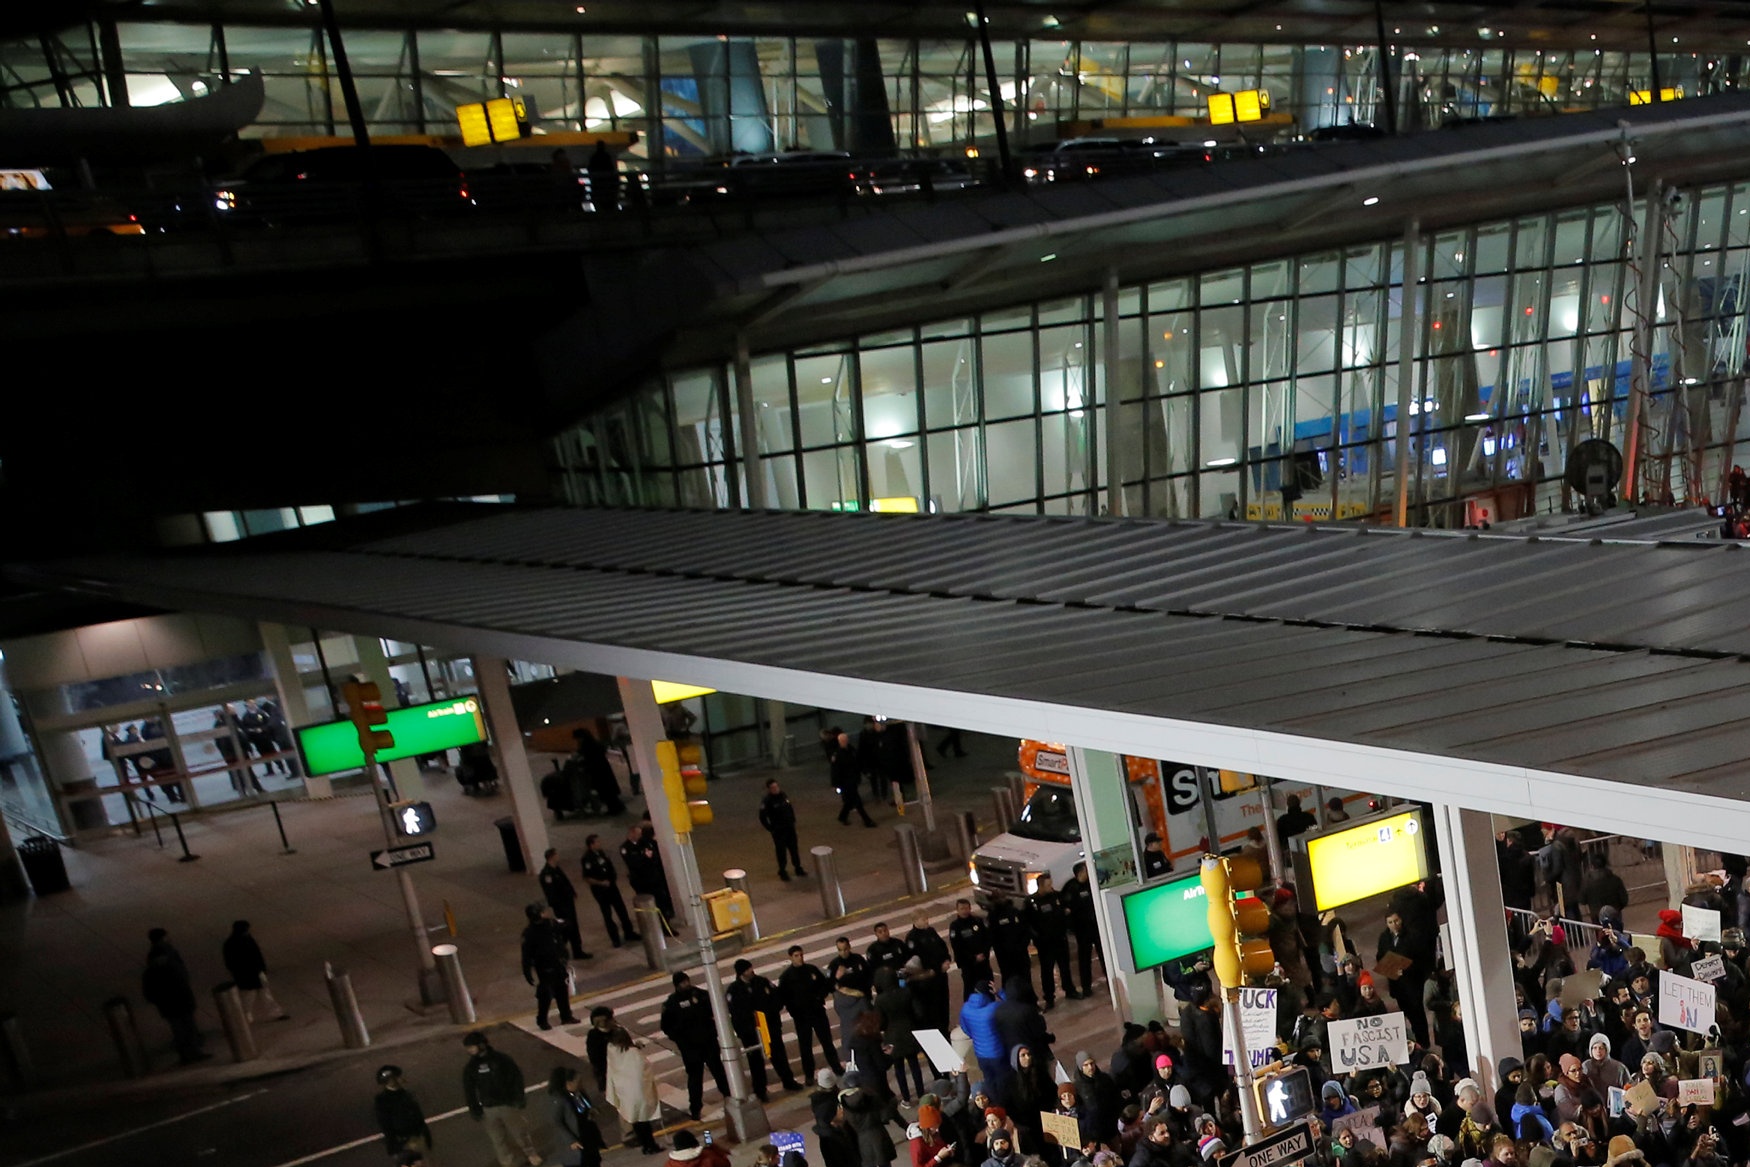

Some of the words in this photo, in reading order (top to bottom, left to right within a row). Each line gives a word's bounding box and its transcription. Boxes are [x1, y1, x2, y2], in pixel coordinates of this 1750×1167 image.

[1239, 990, 1277, 1009] UCK
[1664, 980, 1684, 997] LET
[1687, 987, 1712, 1009] THEM
[1356, 1016, 1383, 1030] NO
[1342, 1027, 1401, 1045] FASCIST
[1224, 1046, 1278, 1067] TUMP
[1276, 1135, 1302, 1160] WAY
